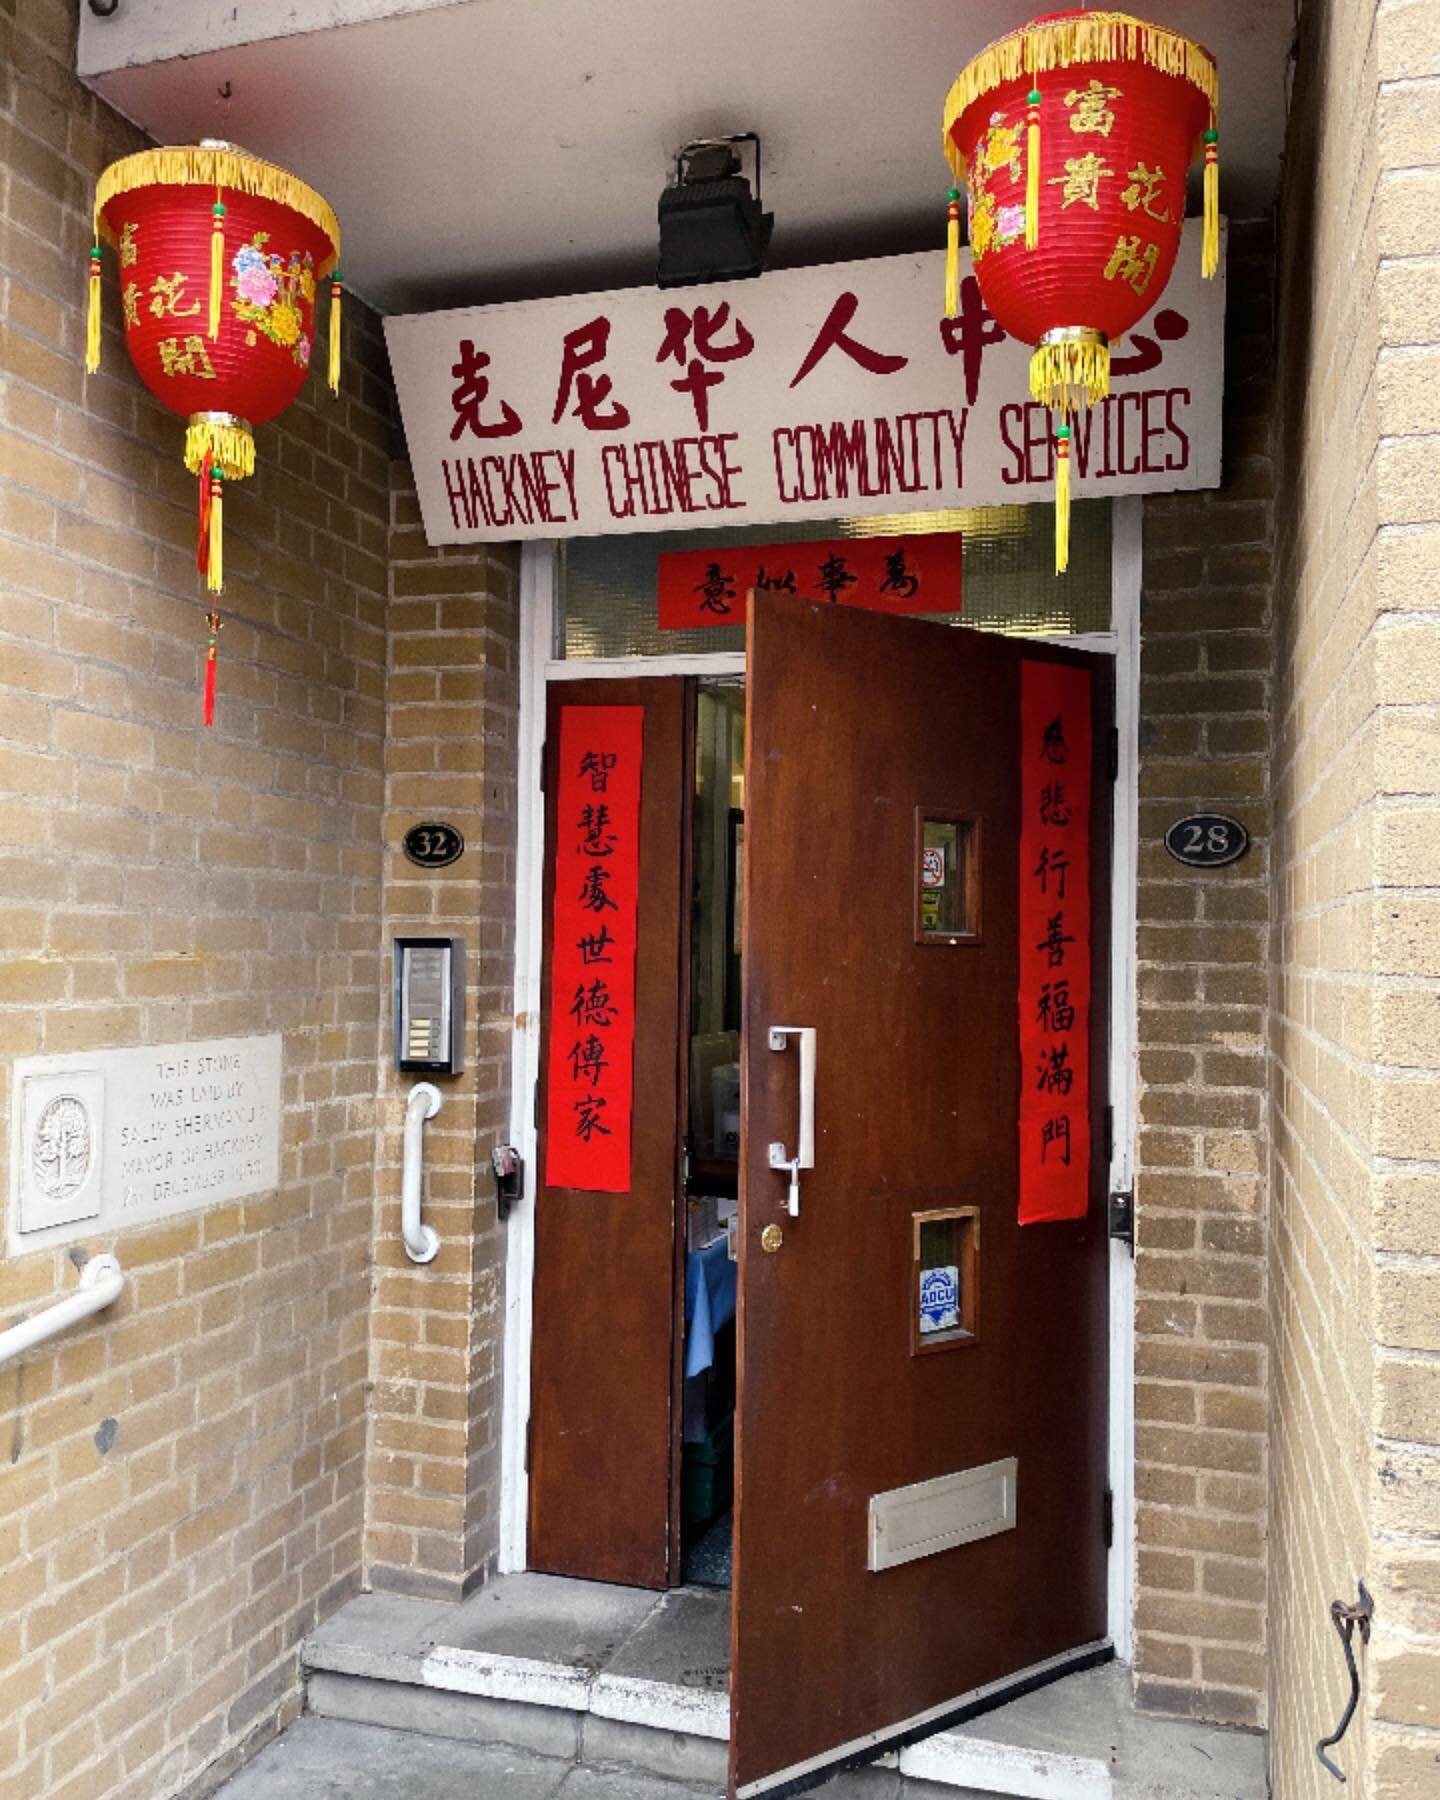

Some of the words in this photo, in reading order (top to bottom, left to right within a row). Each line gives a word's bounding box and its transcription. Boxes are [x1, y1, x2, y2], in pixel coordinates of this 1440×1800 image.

[441, 449, 579, 530] HACKNEY
[601, 432, 747, 518] CHINESE
[773, 407, 968, 502] COMMUNITY
[415, 831, 447, 855] 32
[1183, 825, 1229, 853] 28
[155, 1058, 190, 1079] THIS
[196, 1053, 241, 1075] STONE
[149, 1088, 184, 1109] WAS
